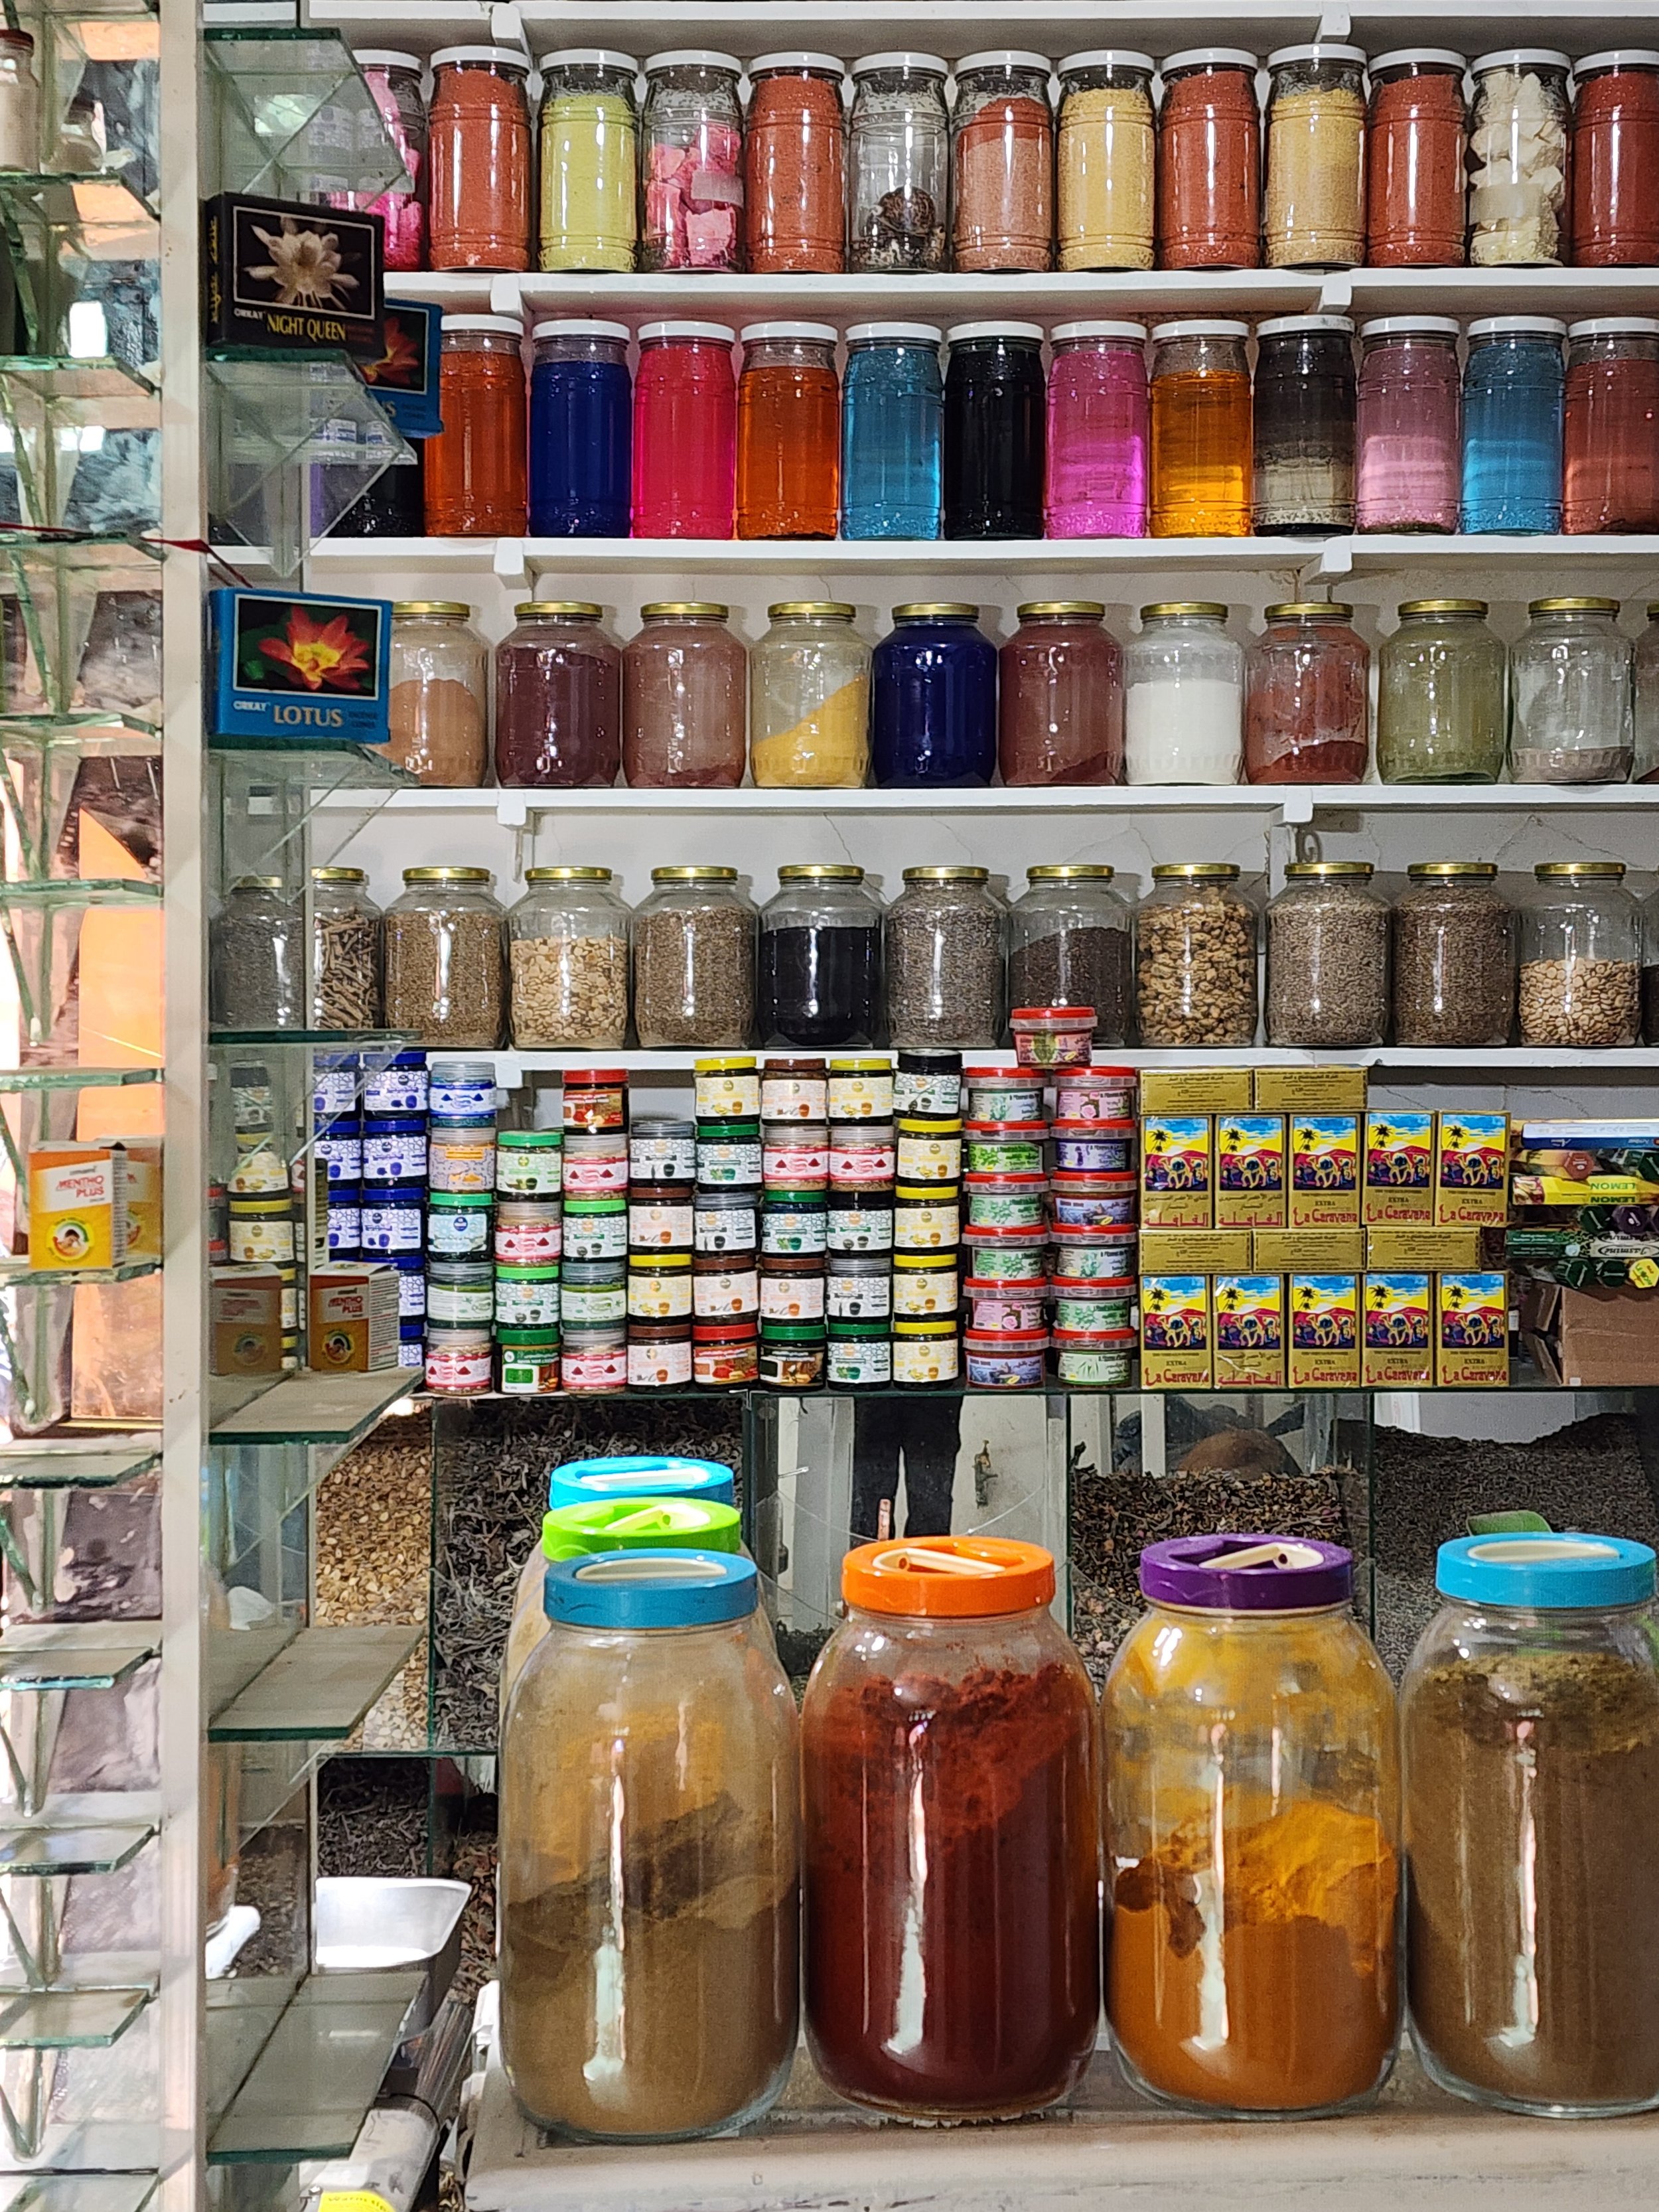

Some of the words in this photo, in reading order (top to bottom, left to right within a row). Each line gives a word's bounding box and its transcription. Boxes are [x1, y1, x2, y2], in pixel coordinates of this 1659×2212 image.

[267, 313, 305, 336] NIGHT
[307, 319, 346, 342] QUEEN
[273, 705, 344, 728] LOTUS
[56, 1175, 104, 1191] MENTHO
[76, 1187, 105, 1198] PLUS
[1144, 1212, 1209, 1226] القافلة
[1218, 1211, 1283, 1226] القافلة
[1293, 1207, 1310, 1226] La
[1366, 1203, 1382, 1222] La
[1439, 1204, 1457, 1223] La
[1604, 1246, 1650, 1256] Jasmine
[1144, 1367, 1161, 1386] La
[1218, 1370, 1281, 1385] القافلة
[1293, 1366, 1310, 1384] La
[1366, 1364, 1382, 1384] La
[1442, 1365, 1459, 1384] La
